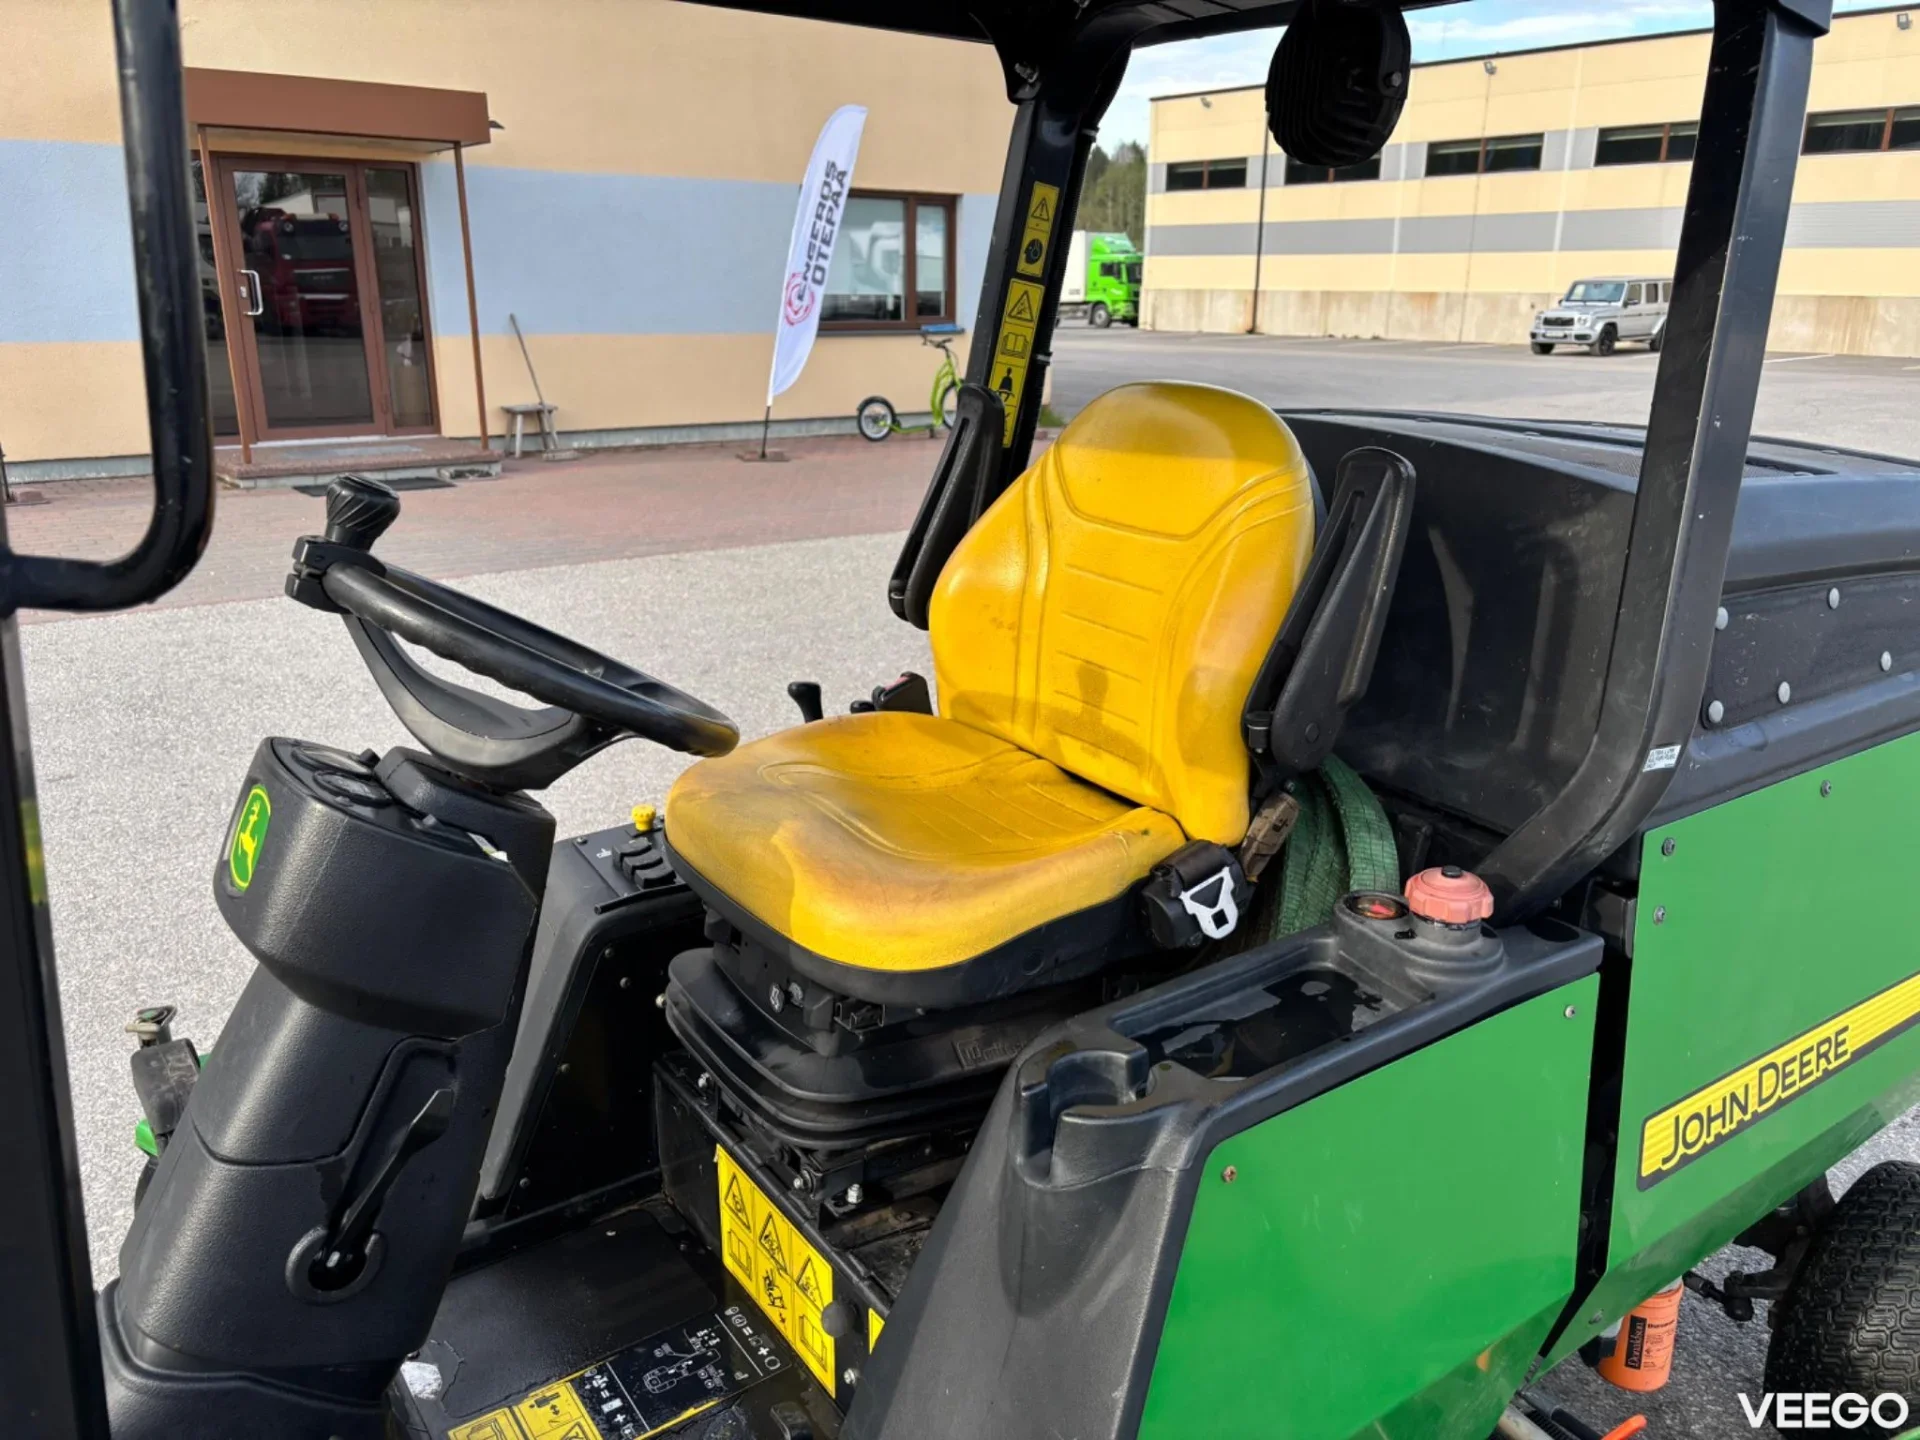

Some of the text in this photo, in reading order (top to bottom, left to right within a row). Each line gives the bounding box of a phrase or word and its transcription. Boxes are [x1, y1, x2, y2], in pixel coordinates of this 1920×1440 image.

[811, 169, 848, 287] OTEPAA
[1661, 1025, 1850, 1167] JOHN DEERE
